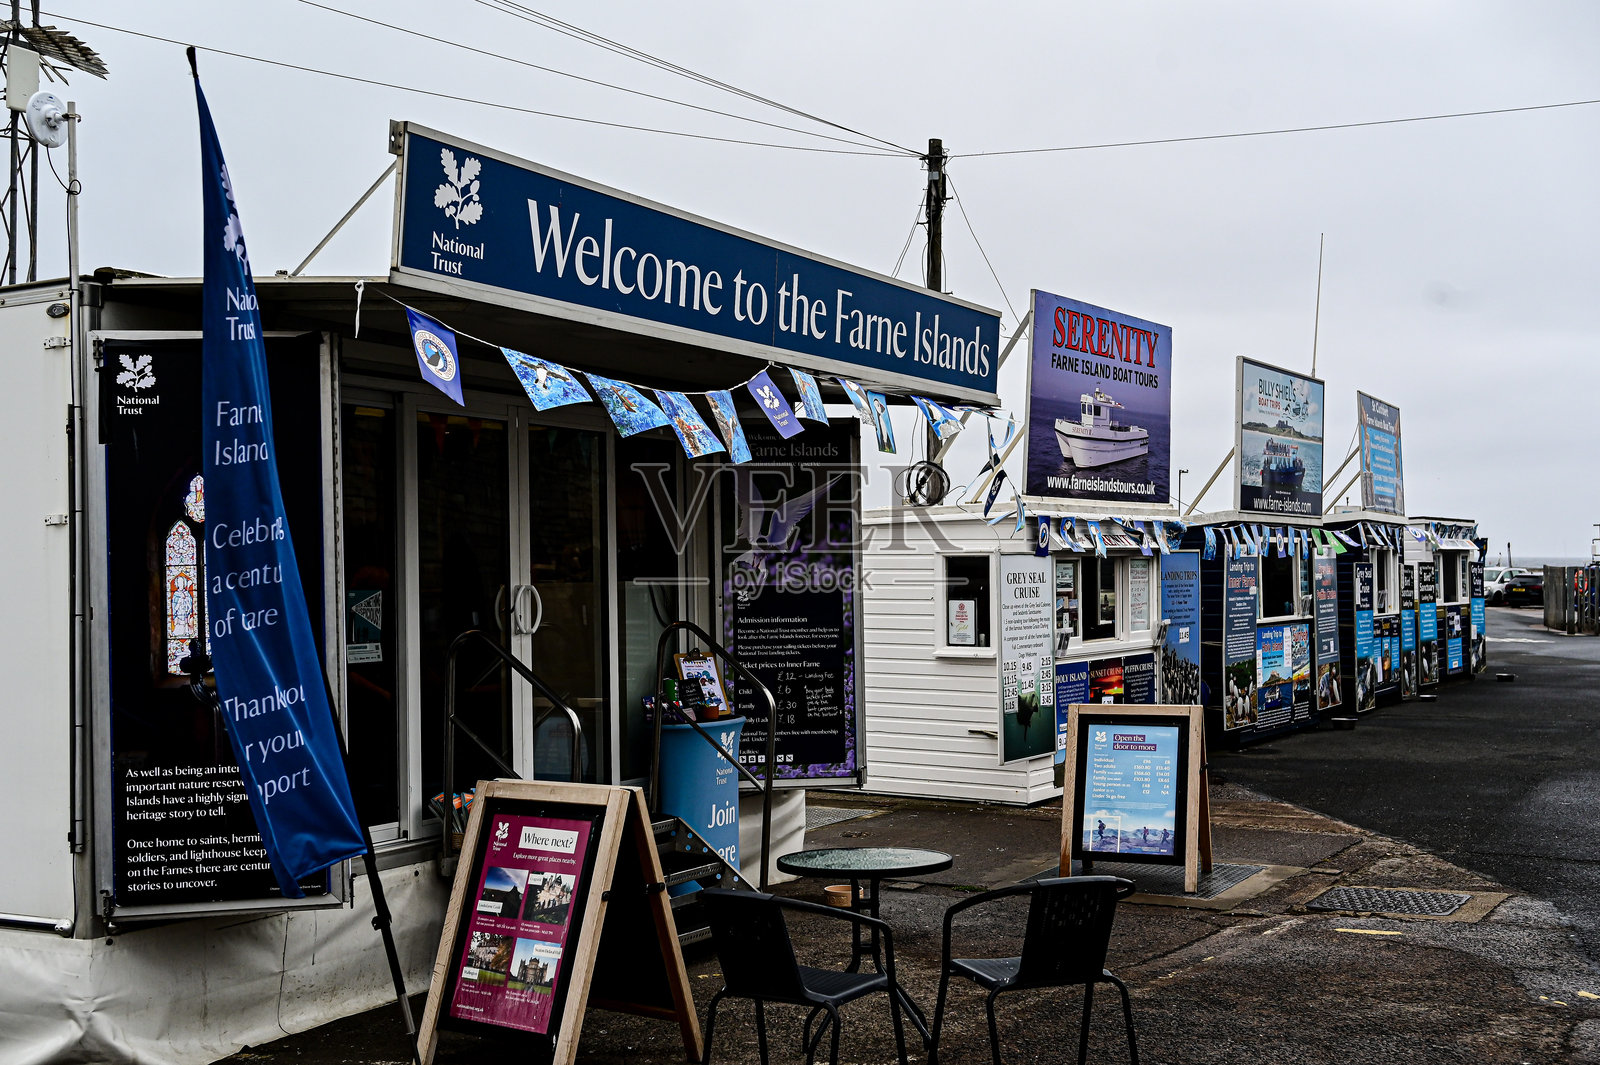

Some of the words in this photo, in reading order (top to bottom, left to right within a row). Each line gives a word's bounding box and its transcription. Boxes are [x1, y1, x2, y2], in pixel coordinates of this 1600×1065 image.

[432, 230, 484, 260] National
[430, 251, 462, 275] Trust
[527, 197, 723, 316] Welcome
[733, 268, 768, 326] to
[777, 273, 827, 341] the
[834, 288, 908, 359] Farne
[914, 311, 990, 378] Islands
[1052, 306, 1160, 368] SERENITY
[1051, 353, 1079, 374] FARNE
[1081, 360, 1110, 381] ISLAND
[1112, 366, 1132, 384] BOAT
[1134, 370, 1158, 389] TOURS
[1258, 378, 1276, 398] BILLY
[1276, 382, 1297, 403] SHIEL'S
[116, 395, 160, 405] National
[1258, 397, 1269, 407] BOAT
[1269, 399, 1281, 410] TRIPS
[116, 405, 143, 415] Trust
[750, 442, 787, 457] Farne
[790, 442, 839, 457] Islands
[1047, 474, 1156, 496] www.farneislandstours.co.uk
[1253, 494, 1312, 514] www.farne-islands.com
[1229, 562, 1243, 573] Landing
[1251, 563, 1255, 571] to
[1356, 567, 1365, 581] Grey
[1365, 567, 1373, 578] Seal
[1006, 572, 1027, 585] GREY
[1028, 572, 1046, 584] SEAL
[1161, 571, 1183, 581] LANDING
[1184, 570, 1197, 580] TRIPS
[1228, 575, 1241, 588] Inner
[1242, 574, 1256, 588] Farne
[212, 575, 222, 595] a
[1419, 582, 1435, 594] Sanctuary
[1013, 586, 1040, 599] CRUISE
[214, 607, 236, 638] of
[1261, 630, 1273, 640] Landing
[1292, 629, 1308, 641] Sunset
[1261, 641, 1271, 655] Holy
[1271, 640, 1283, 651] Island
[1090, 669, 1107, 679] SUNSET
[1107, 666, 1123, 677] CRUISE
[1124, 664, 1139, 674] PUFFIN
[1139, 662, 1154, 671] CRUISE
[1003, 674, 1017, 686] 11:15
[1055, 673, 1069, 684] HOLY
[1069, 671, 1087, 682] ISLAND
[738, 702, 755, 710] Family
[1114, 734, 1132, 743] Open
[126, 768, 138, 778] As
[140, 766, 160, 777] well
[162, 768, 173, 777] as
[175, 765, 203, 778] being
[204, 766, 217, 775] an
[715, 768, 734, 777] National
[716, 775, 727, 786] Trust
[126, 781, 176, 794] important
[179, 781, 211, 790] nature
[126, 796, 161, 807] Islands
[162, 795, 186, 805] have
[187, 796, 193, 804] a
[195, 792, 224, 805] highly
[126, 809, 167, 821] heritage
[168, 809, 194, 820] story
[195, 808, 207, 817] to
[208, 806, 226, 817] tell.
[707, 800, 736, 829] Join
[127, 839, 154, 849] Once
[155, 837, 185, 848] home
[186, 837, 198, 846] to
[199, 835, 230, 846] saints,
[524, 832, 550, 846] Where
[550, 837, 574, 848] next?
[127, 852, 168, 864] soldiers,
[169, 850, 189, 861] and
[190, 848, 241, 861] lighthouse
[513, 851, 527, 860] Explore
[127, 869, 141, 878] on
[142, 866, 160, 877] the
[161, 865, 193, 876] Farnes
[195, 863, 221, 874] there
[222, 864, 239, 873] are
[127, 881, 161, 892] stories
[162, 882, 174, 891] to
[175, 880, 217, 889] uncover.
